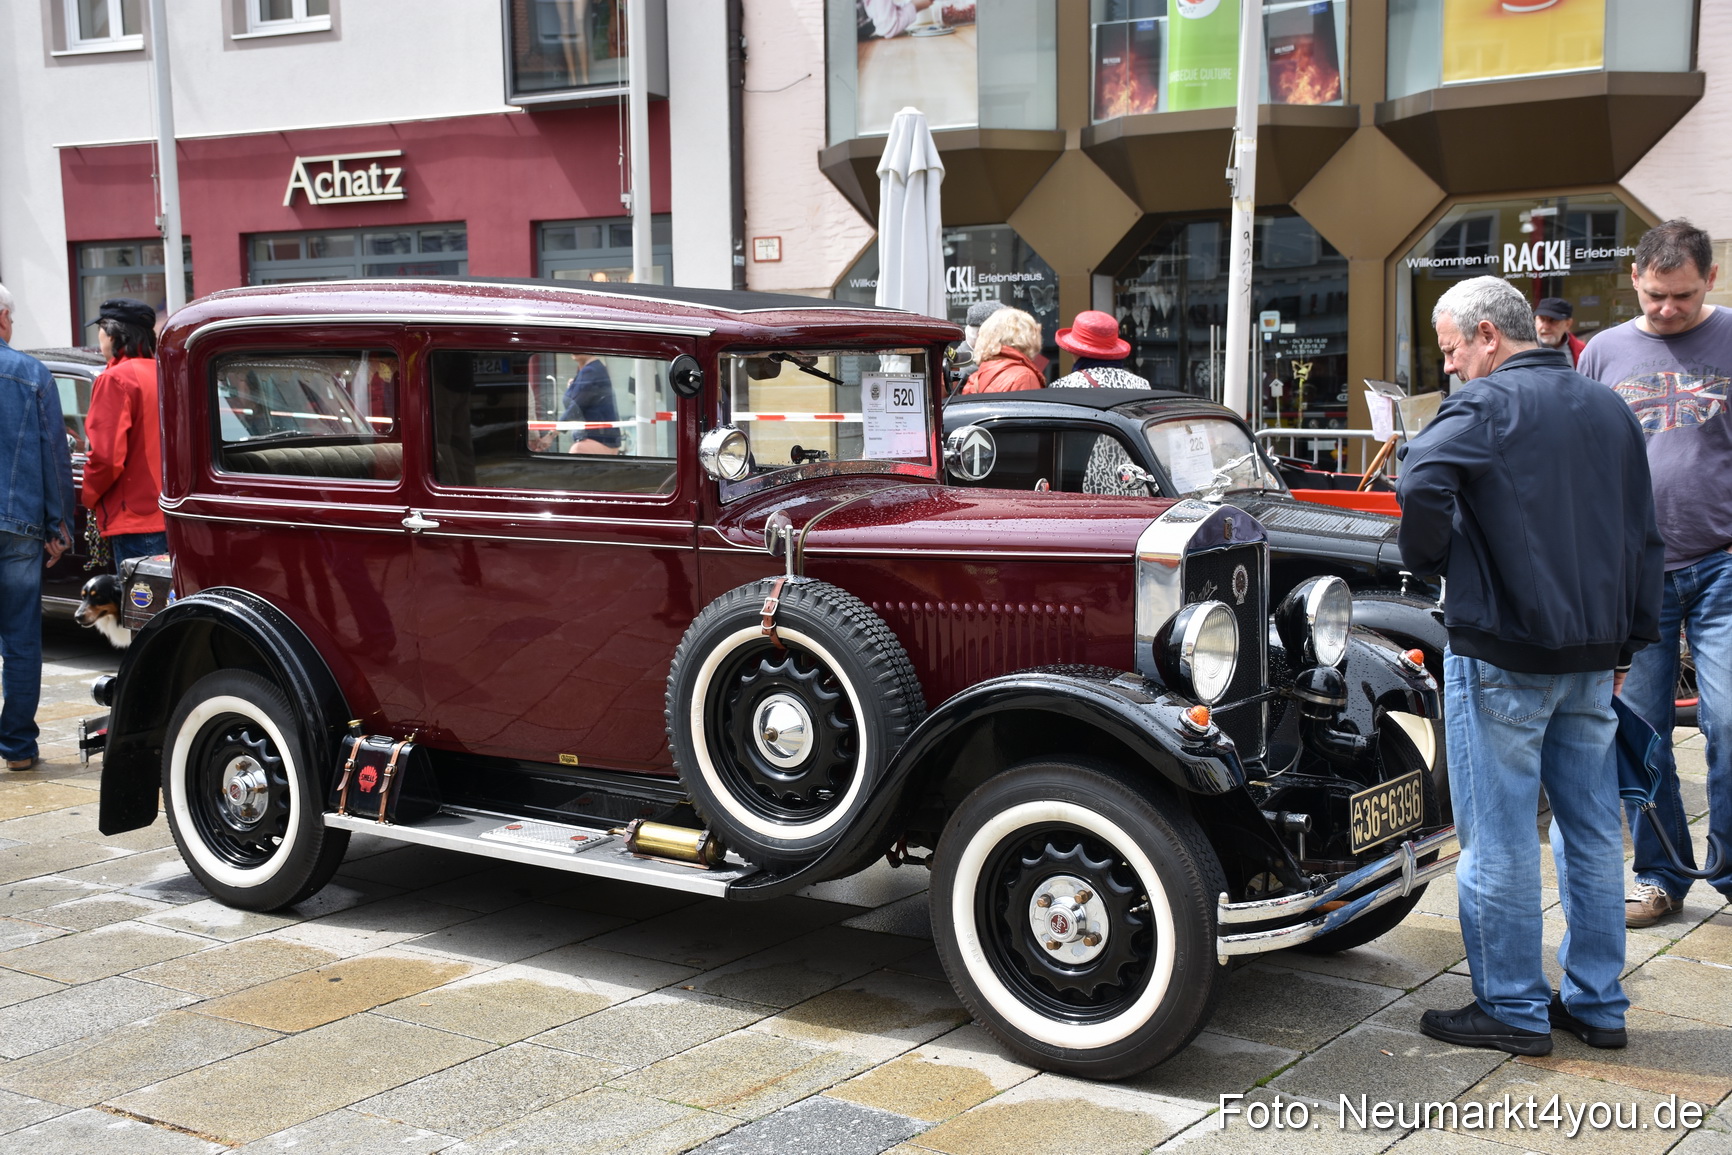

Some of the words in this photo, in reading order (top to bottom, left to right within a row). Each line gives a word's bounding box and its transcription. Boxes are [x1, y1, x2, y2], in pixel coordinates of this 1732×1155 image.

[1200, 68, 1232, 80] CULTURE
[283, 154, 403, 206] Achatz
[1406, 254, 1482, 268] Willkommen
[1484, 253, 1500, 264] im
[1504, 240, 1570, 272] RACKL
[945, 266, 978, 292] CKL
[978, 272, 1044, 284] Erlebnishaus.
[893, 388, 915, 406] 520
[1190, 437, 1204, 452] 226
[1363, 779, 1421, 841] 36-6396
